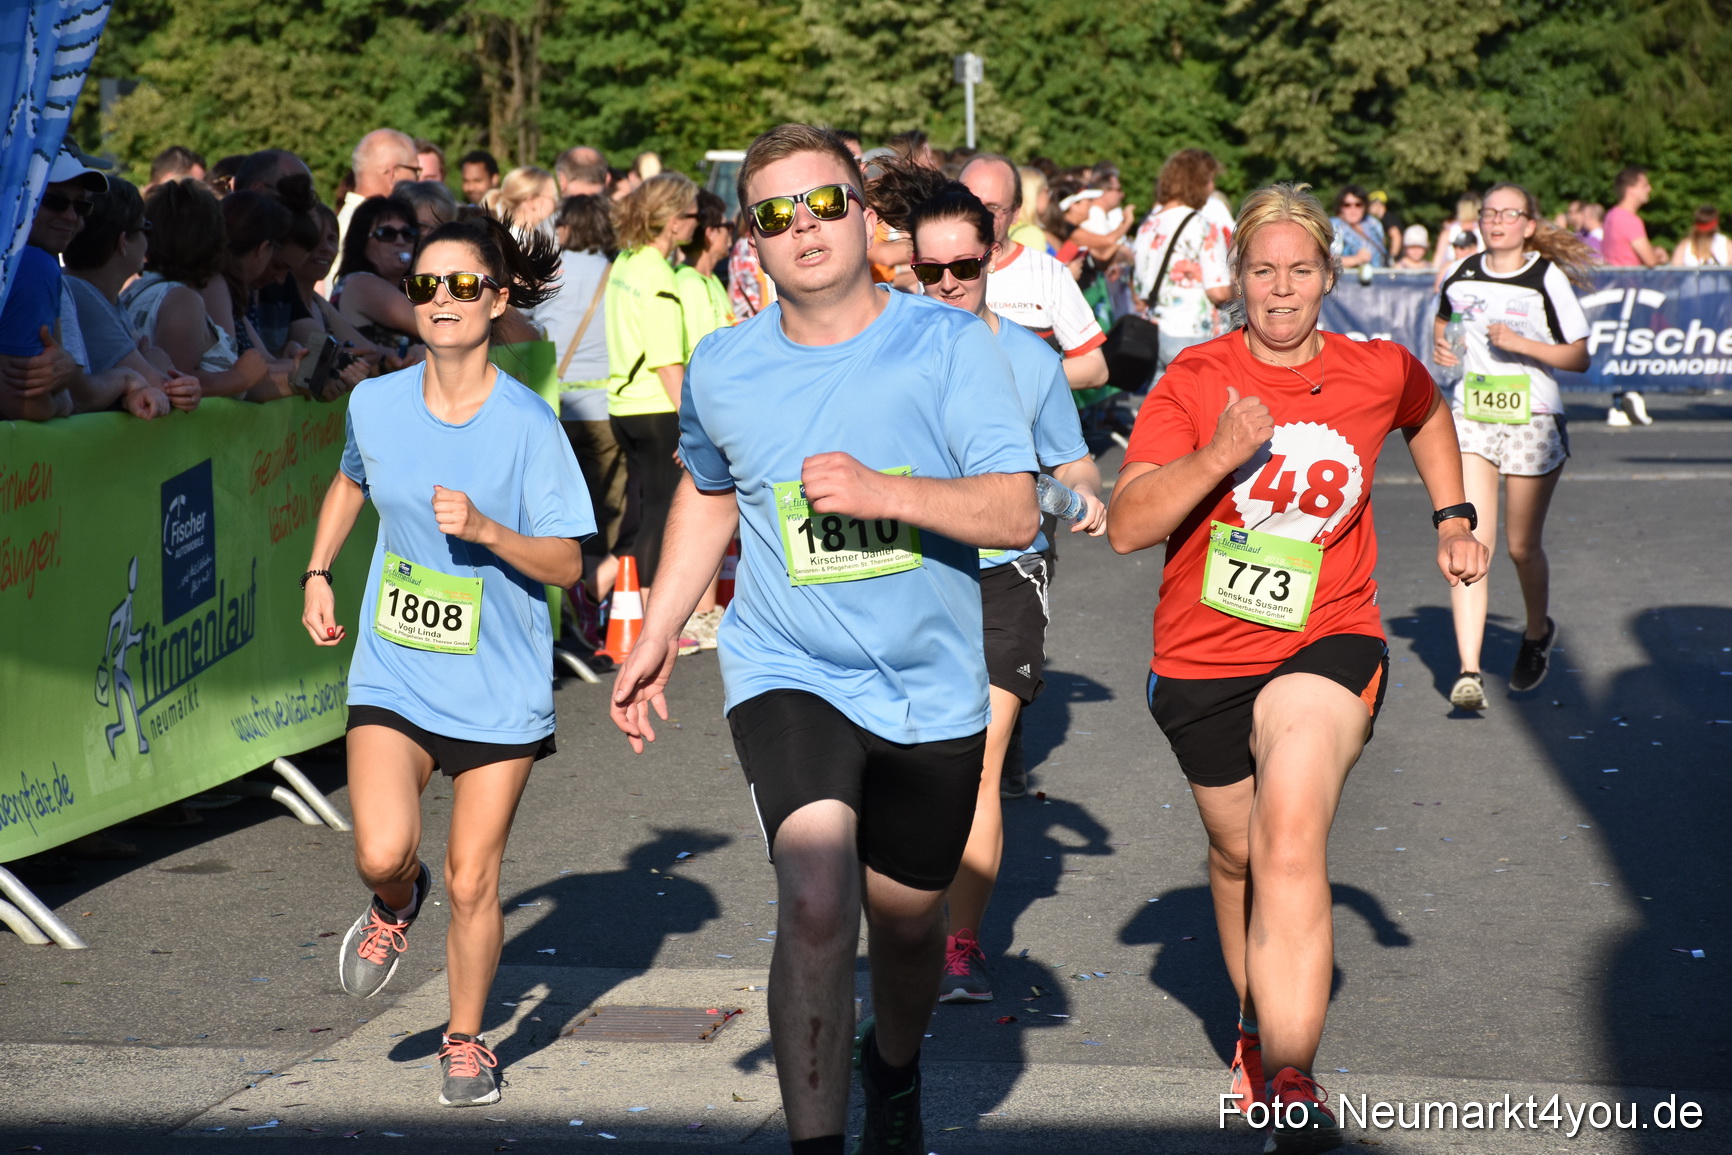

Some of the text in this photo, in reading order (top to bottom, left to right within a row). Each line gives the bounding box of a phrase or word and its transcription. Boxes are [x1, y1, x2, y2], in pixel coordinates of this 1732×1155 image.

[987, 301, 1034, 310] NEUMARKT
[1472, 390, 1521, 409] 1480
[0, 461, 53, 514] irmen
[1248, 454, 1350, 519] 48
[171, 511, 207, 547] Fischer
[798, 515, 899, 554] 1810
[0, 505, 62, 600] änger!
[174, 535, 205, 560] AUTOMOBILE
[810, 546, 894, 566] Kirschner Daniel
[1221, 538, 1262, 554] firmenlauf
[795, 566, 820, 575] Senioren-
[826, 563, 859, 573] Pflegeheim
[870, 558, 894, 566] Therese
[895, 552, 914, 561] GmbH
[1228, 558, 1292, 602] 773
[388, 588, 463, 632] 1808
[1217, 587, 1253, 605] Denskus
[1255, 599, 1293, 614] Susanne
[1222, 599, 1265, 615] Hammerbacher
[1266, 610, 1286, 619] GmbH
[140, 556, 256, 704] firmenlauf
[398, 622, 415, 634] Vogl
[418, 627, 442, 639] Linda
[150, 682, 199, 741] neumarkt
